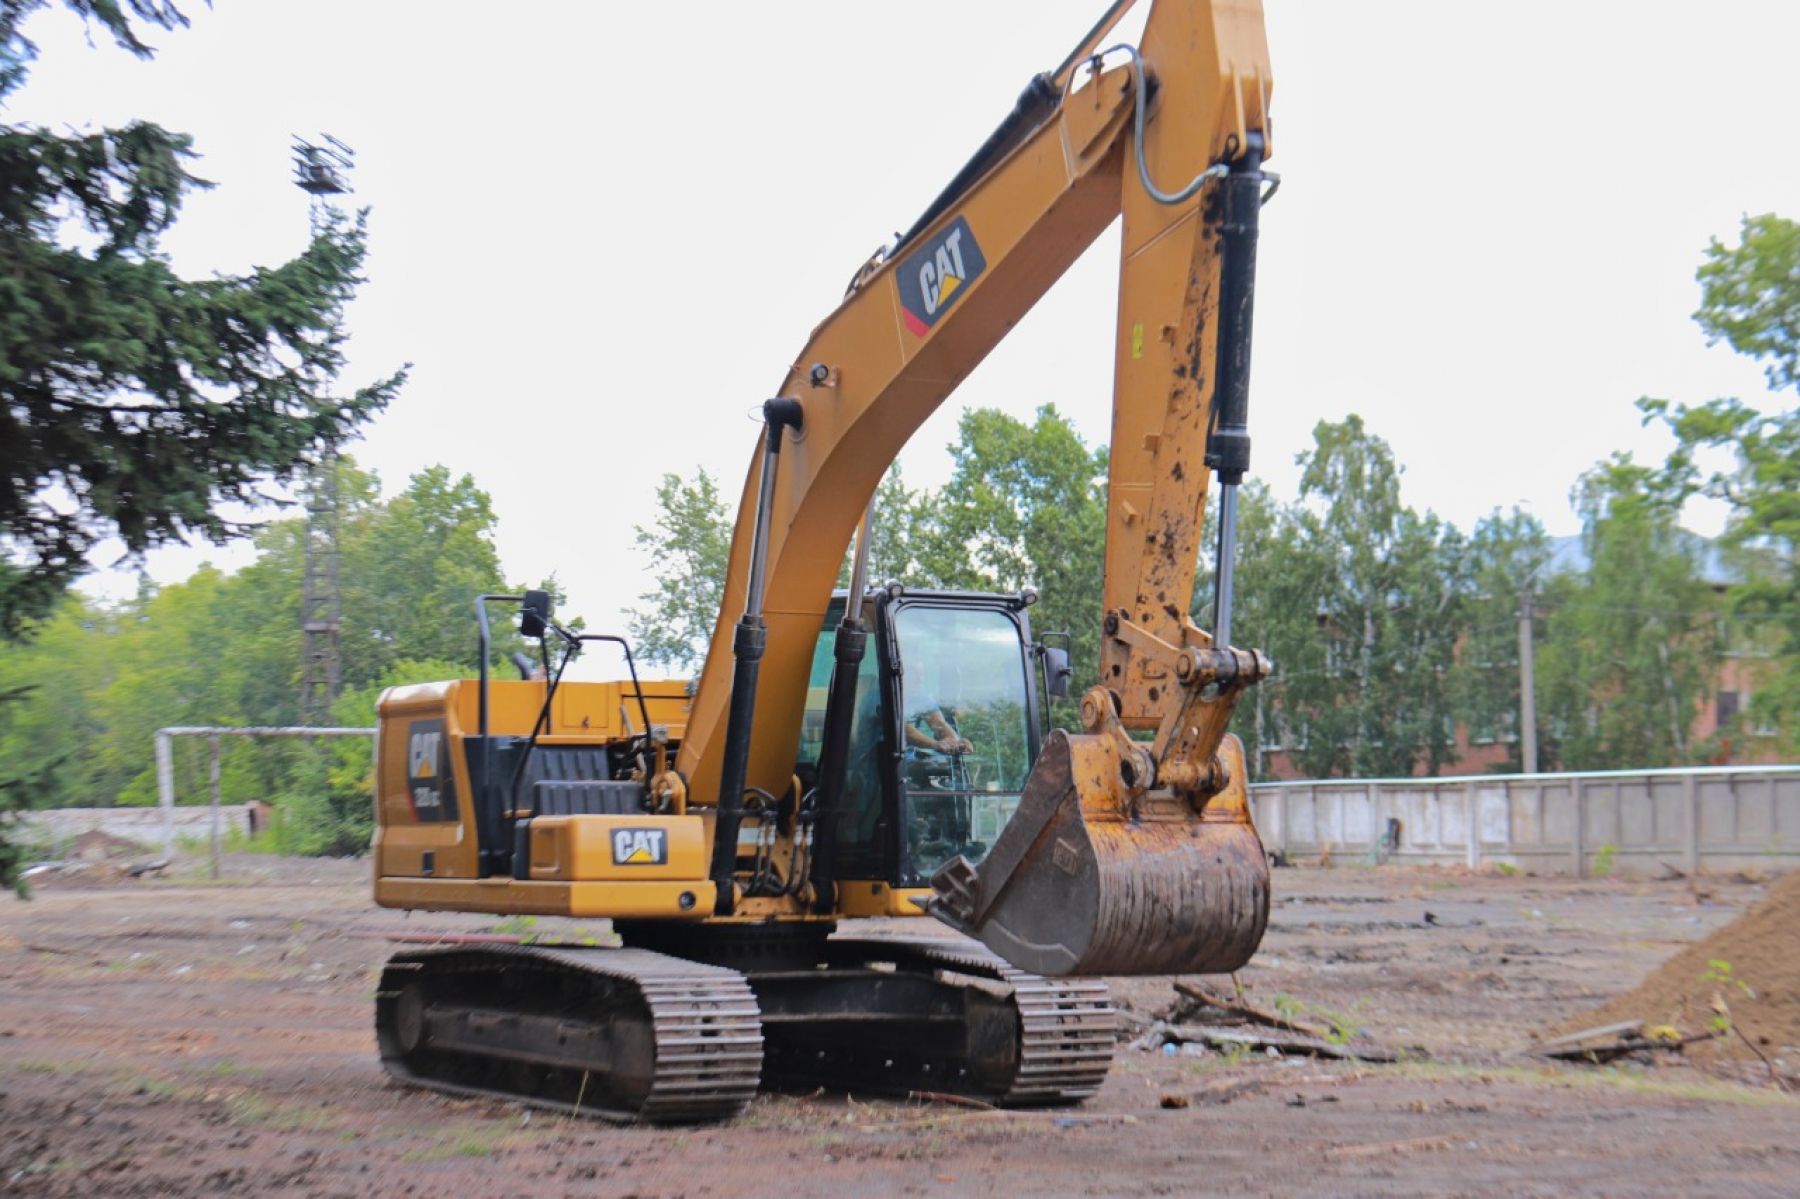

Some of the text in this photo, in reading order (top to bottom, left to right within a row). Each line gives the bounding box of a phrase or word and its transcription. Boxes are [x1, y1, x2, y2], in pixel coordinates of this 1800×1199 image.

[919, 227, 965, 315] CAT
[410, 732, 441, 778] CAT
[615, 830, 662, 863] CAT
